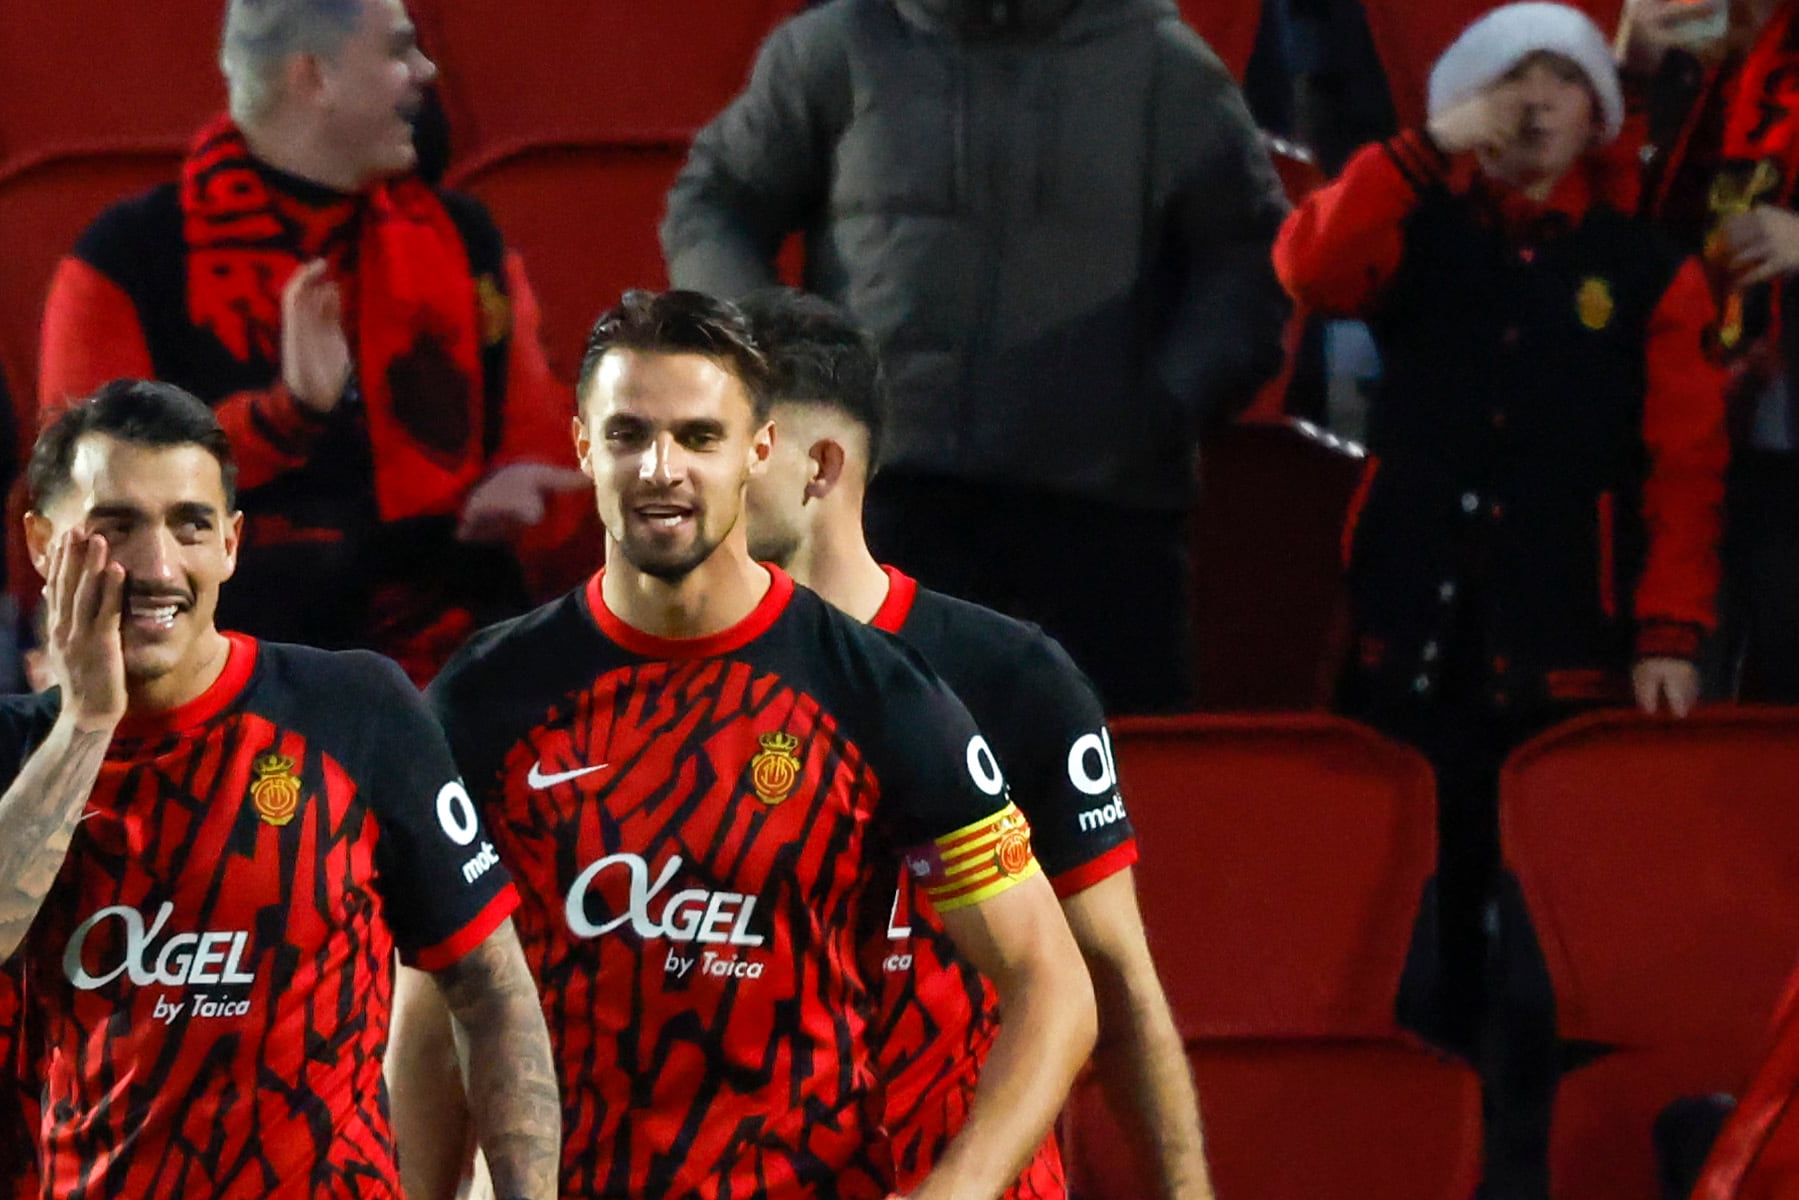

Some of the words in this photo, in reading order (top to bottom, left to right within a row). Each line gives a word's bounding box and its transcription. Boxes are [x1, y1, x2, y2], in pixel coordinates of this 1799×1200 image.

[664, 948, 694, 979] by
[701, 951, 764, 979] Taica
[152, 994, 185, 1025] by
[190, 994, 250, 1017] Taica
